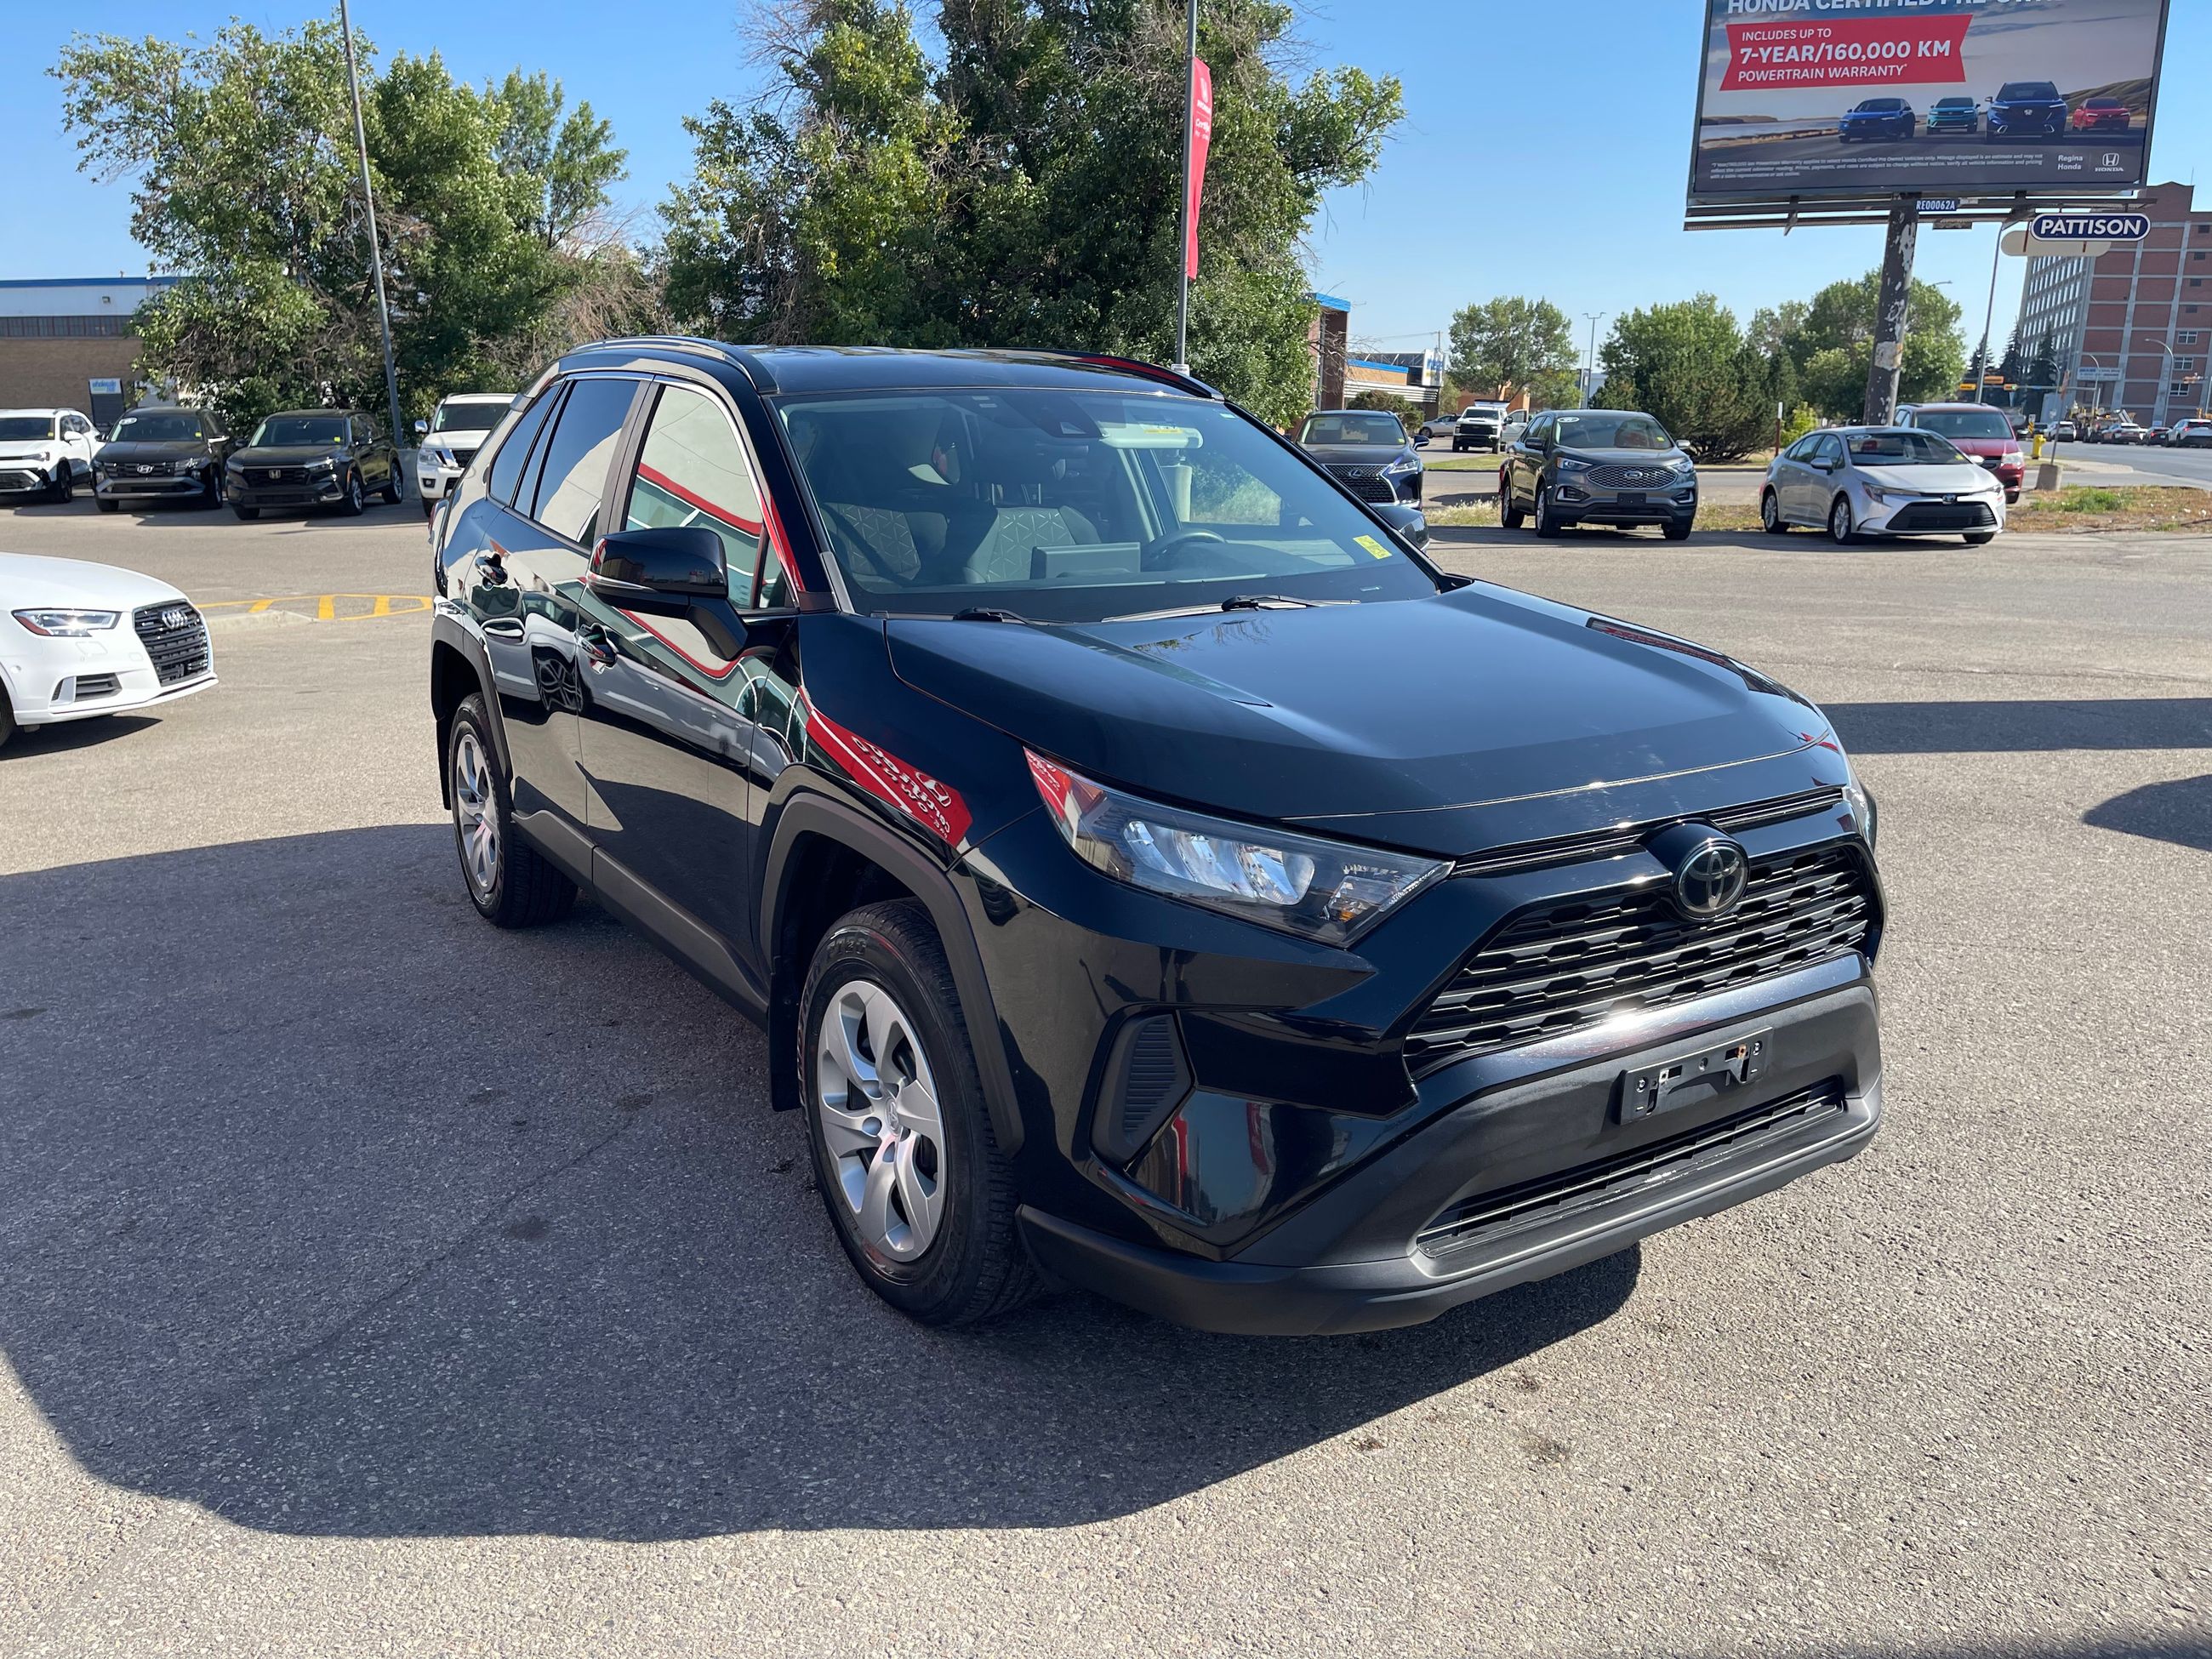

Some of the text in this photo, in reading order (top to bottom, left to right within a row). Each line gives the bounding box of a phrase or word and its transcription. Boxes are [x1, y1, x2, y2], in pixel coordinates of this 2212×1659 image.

[1742, 28, 1832, 41] INCLUDES UP TO
[1739, 40, 1951, 65] 7-YEAR/160,000 KM
[1738, 68, 1825, 83] POWERTRAIN
[2040, 219, 2141, 236] PATTISON
